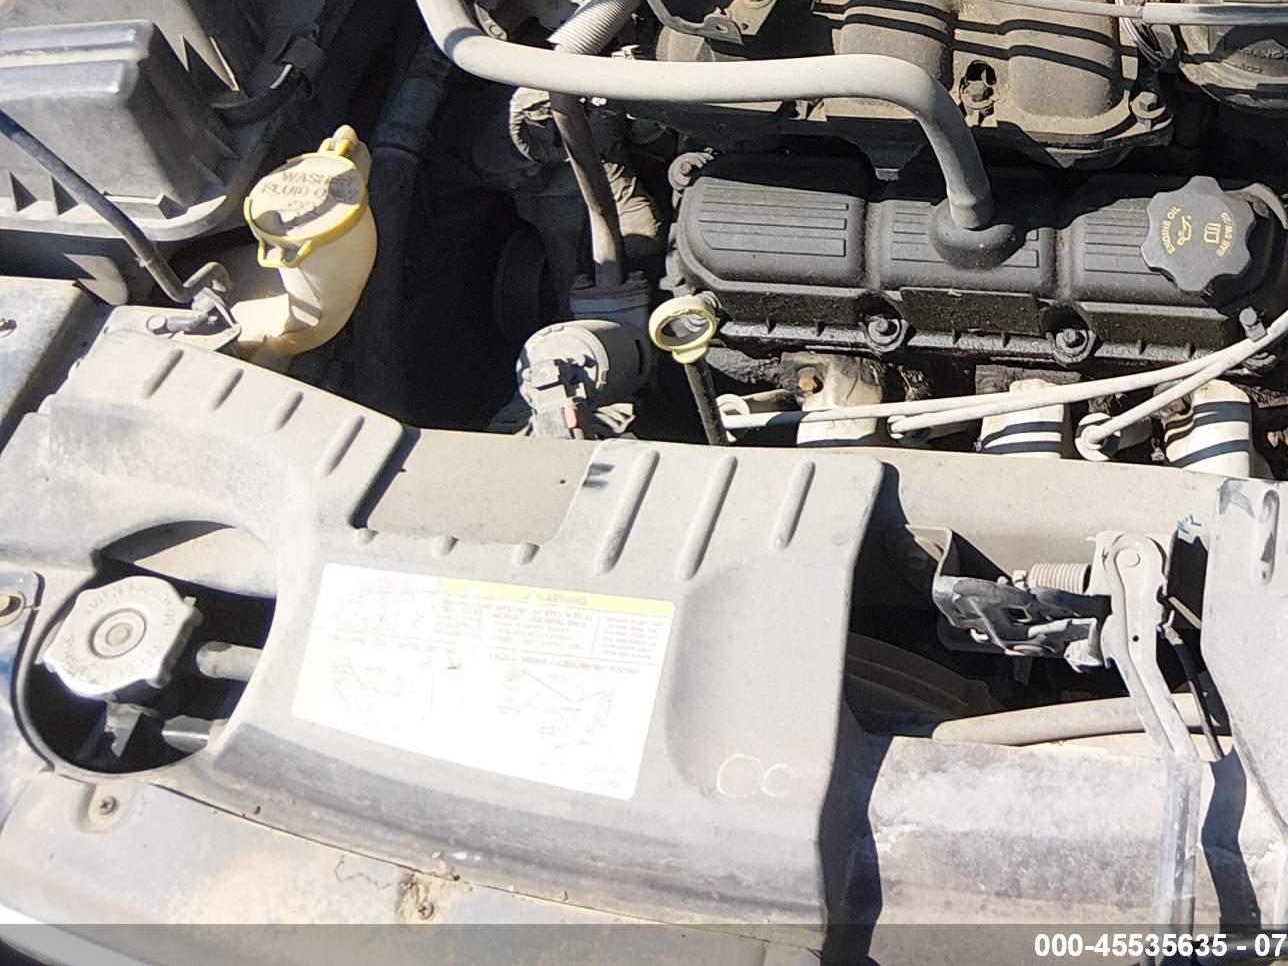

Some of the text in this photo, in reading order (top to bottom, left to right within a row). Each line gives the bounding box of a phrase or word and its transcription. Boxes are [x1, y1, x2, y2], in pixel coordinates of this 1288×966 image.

[261, 183, 309, 196] FLUID
[1161, 205, 1182, 255] ENGINE OIL
